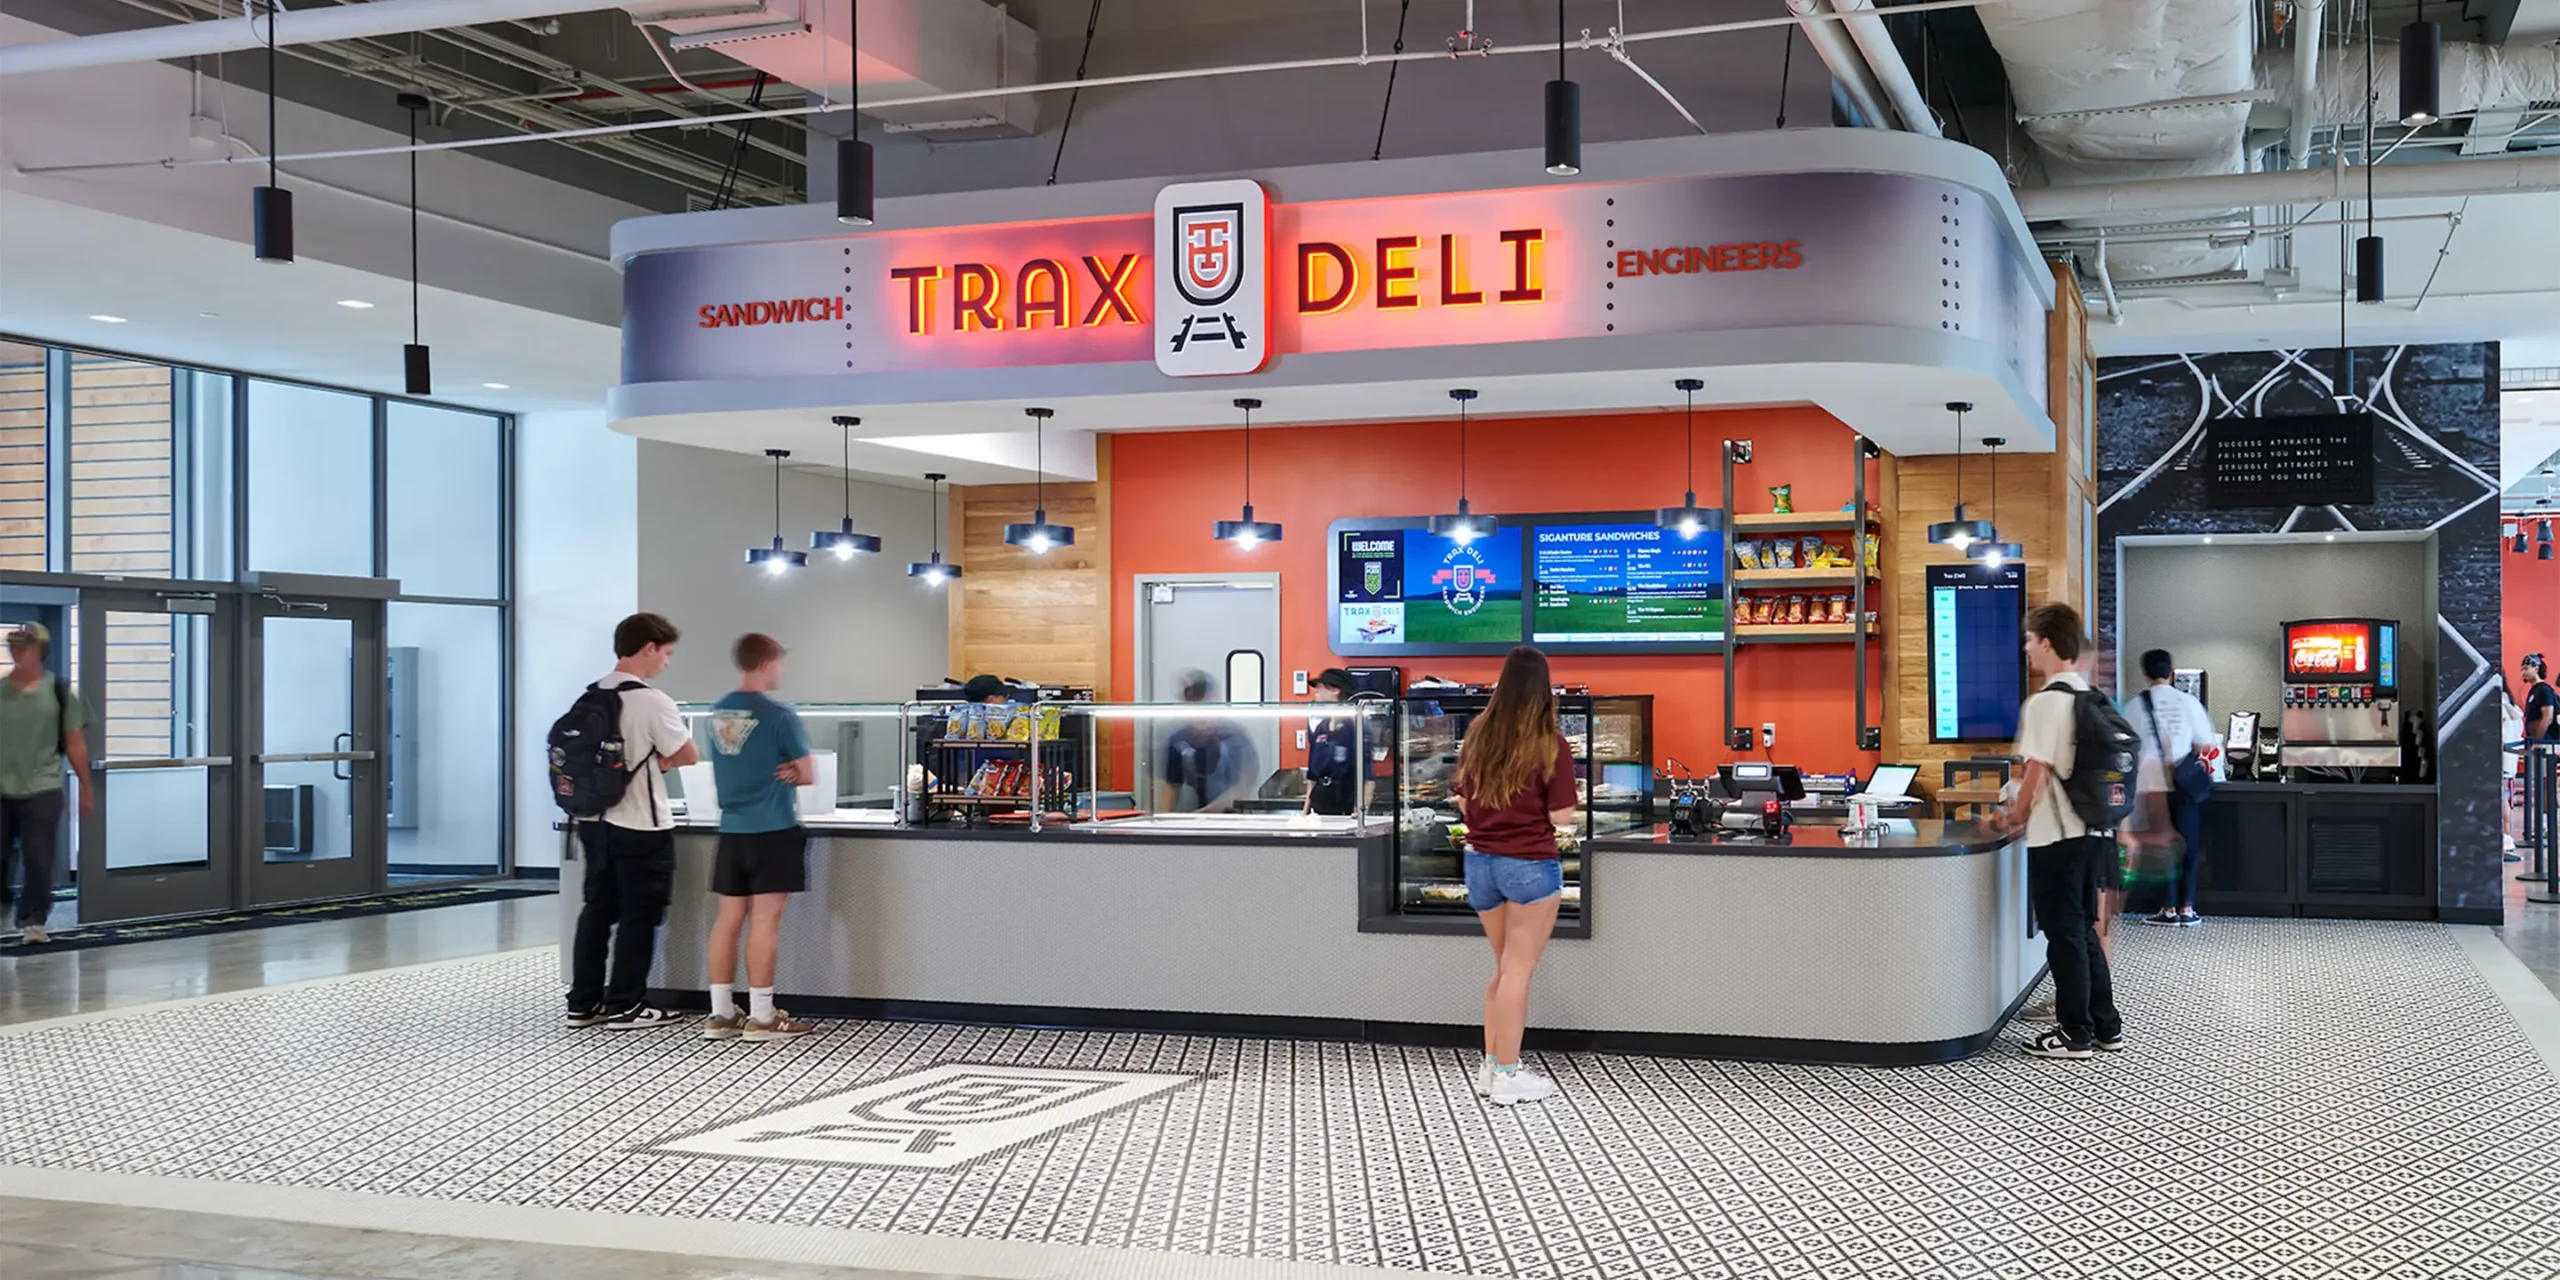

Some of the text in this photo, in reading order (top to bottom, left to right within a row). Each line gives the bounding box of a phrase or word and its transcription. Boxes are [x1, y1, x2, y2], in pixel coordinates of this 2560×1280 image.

[1617, 241, 1802, 278] ENGINEERS
[891, 228, 1546, 335] TRAX DELI
[698, 296, 844, 328] SANDWICH
[2218, 440, 2262, 448] SUCCESS
[2270, 438, 2321, 446] ATTRACTS
[2218, 463, 2268, 471] STRUGGLE
[2276, 461, 2328, 469] ATTRACTS
[2218, 474, 2262, 482] FRIENDS
[1539, 531, 1660, 543] SIGANTURE SANDWICHES
[1351, 540, 1395, 551] WELCOME
[1443, 546, 1485, 565] TRAX DELI
[1344, 607, 1371, 617] TRAX
